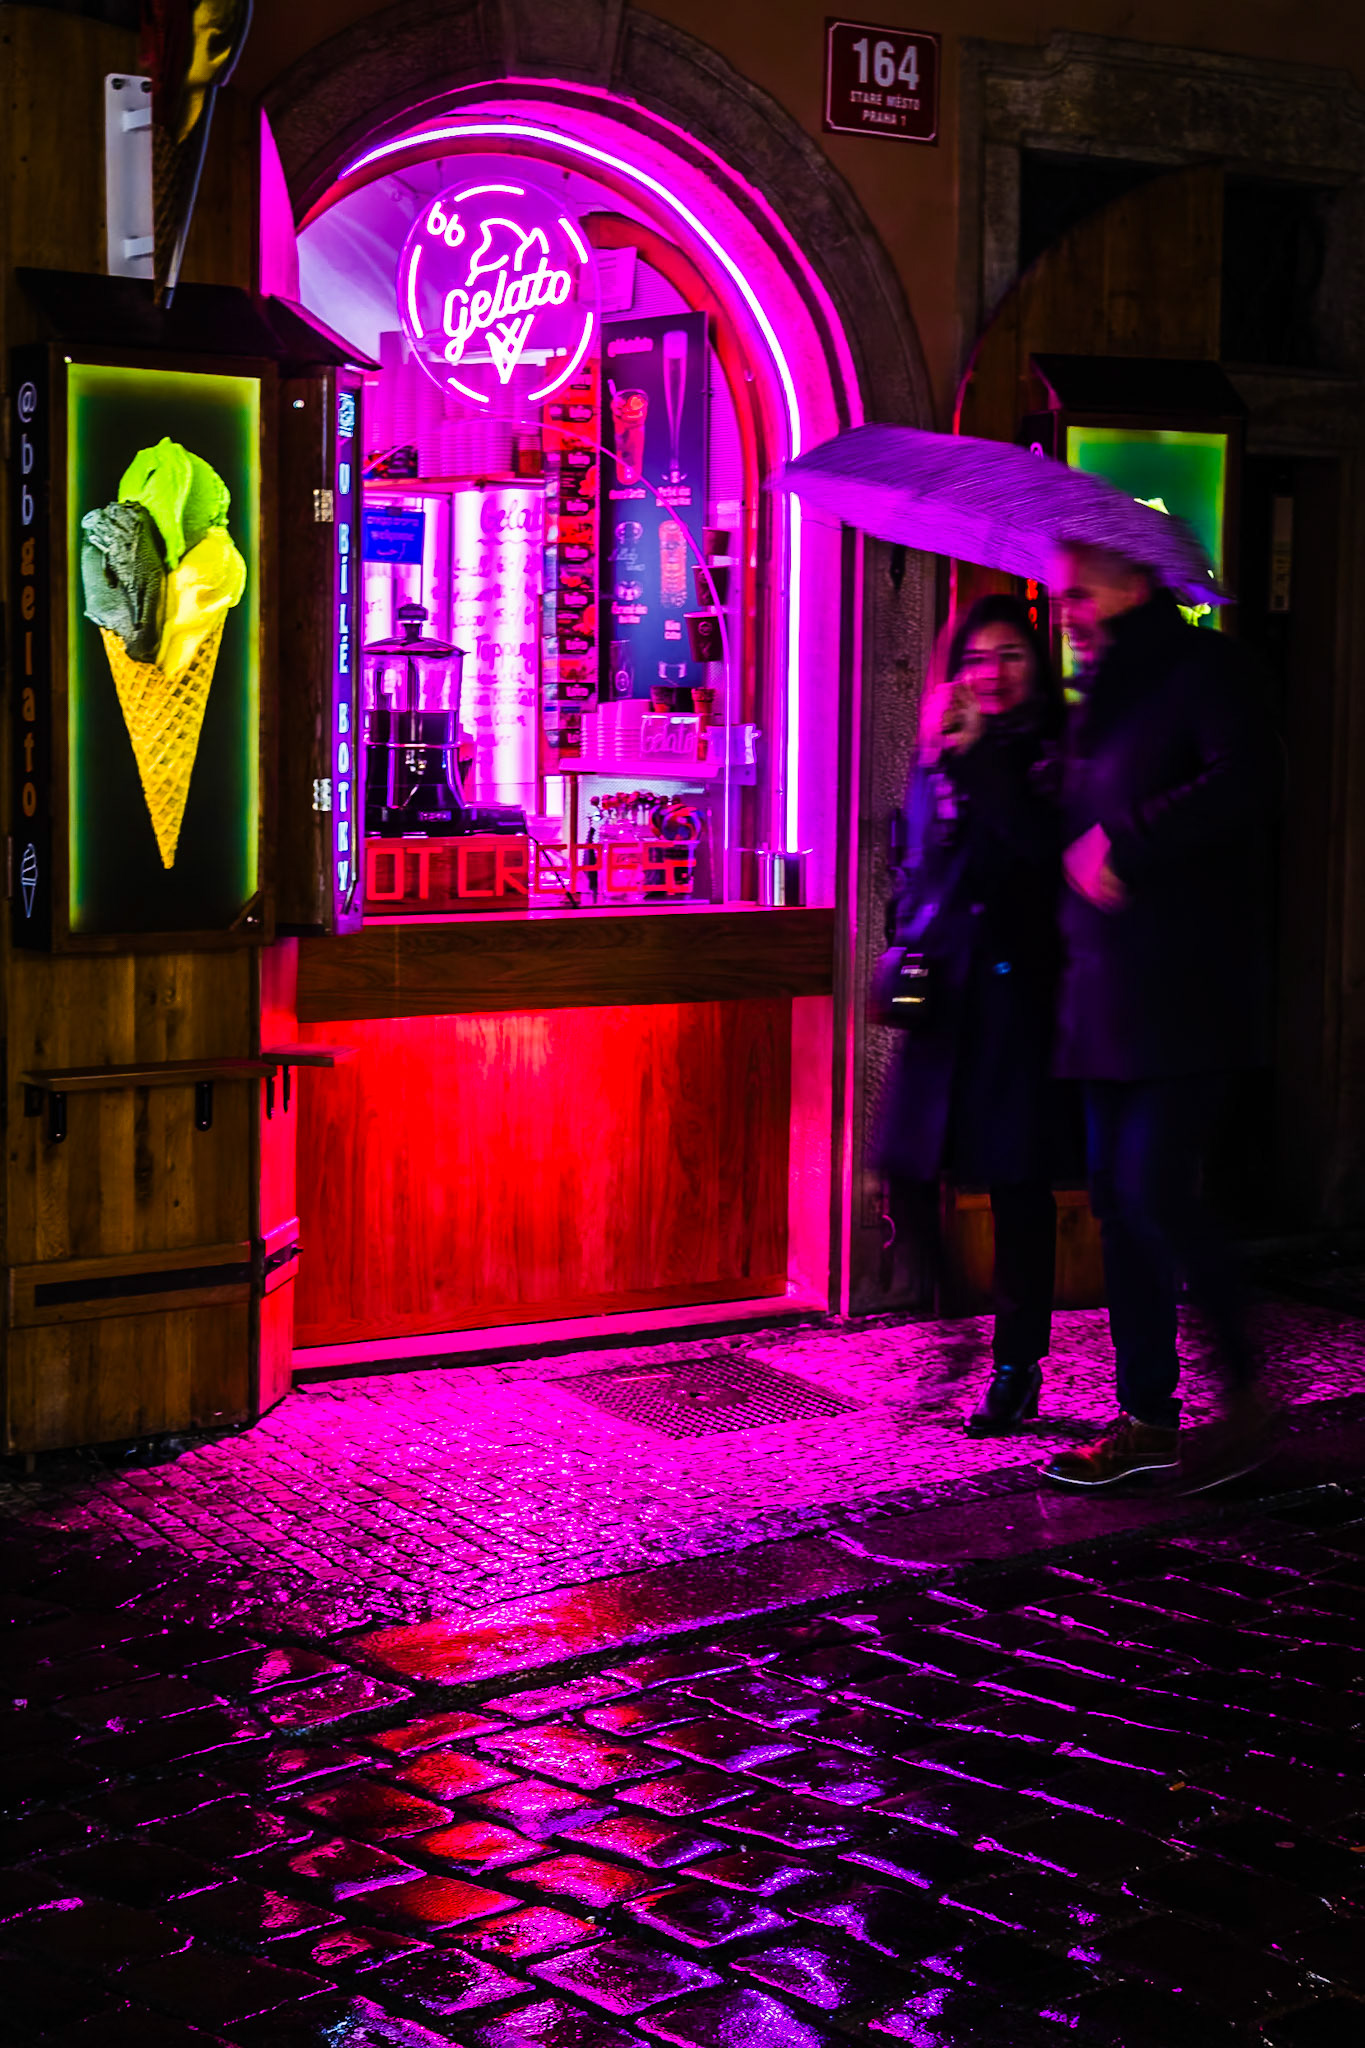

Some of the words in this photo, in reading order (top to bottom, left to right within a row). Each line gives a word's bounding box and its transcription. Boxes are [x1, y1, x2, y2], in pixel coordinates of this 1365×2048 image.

[852, 37, 919, 90] 164
[862, 110, 897, 125] PRAHA
[900, 115, 907, 126] 1
